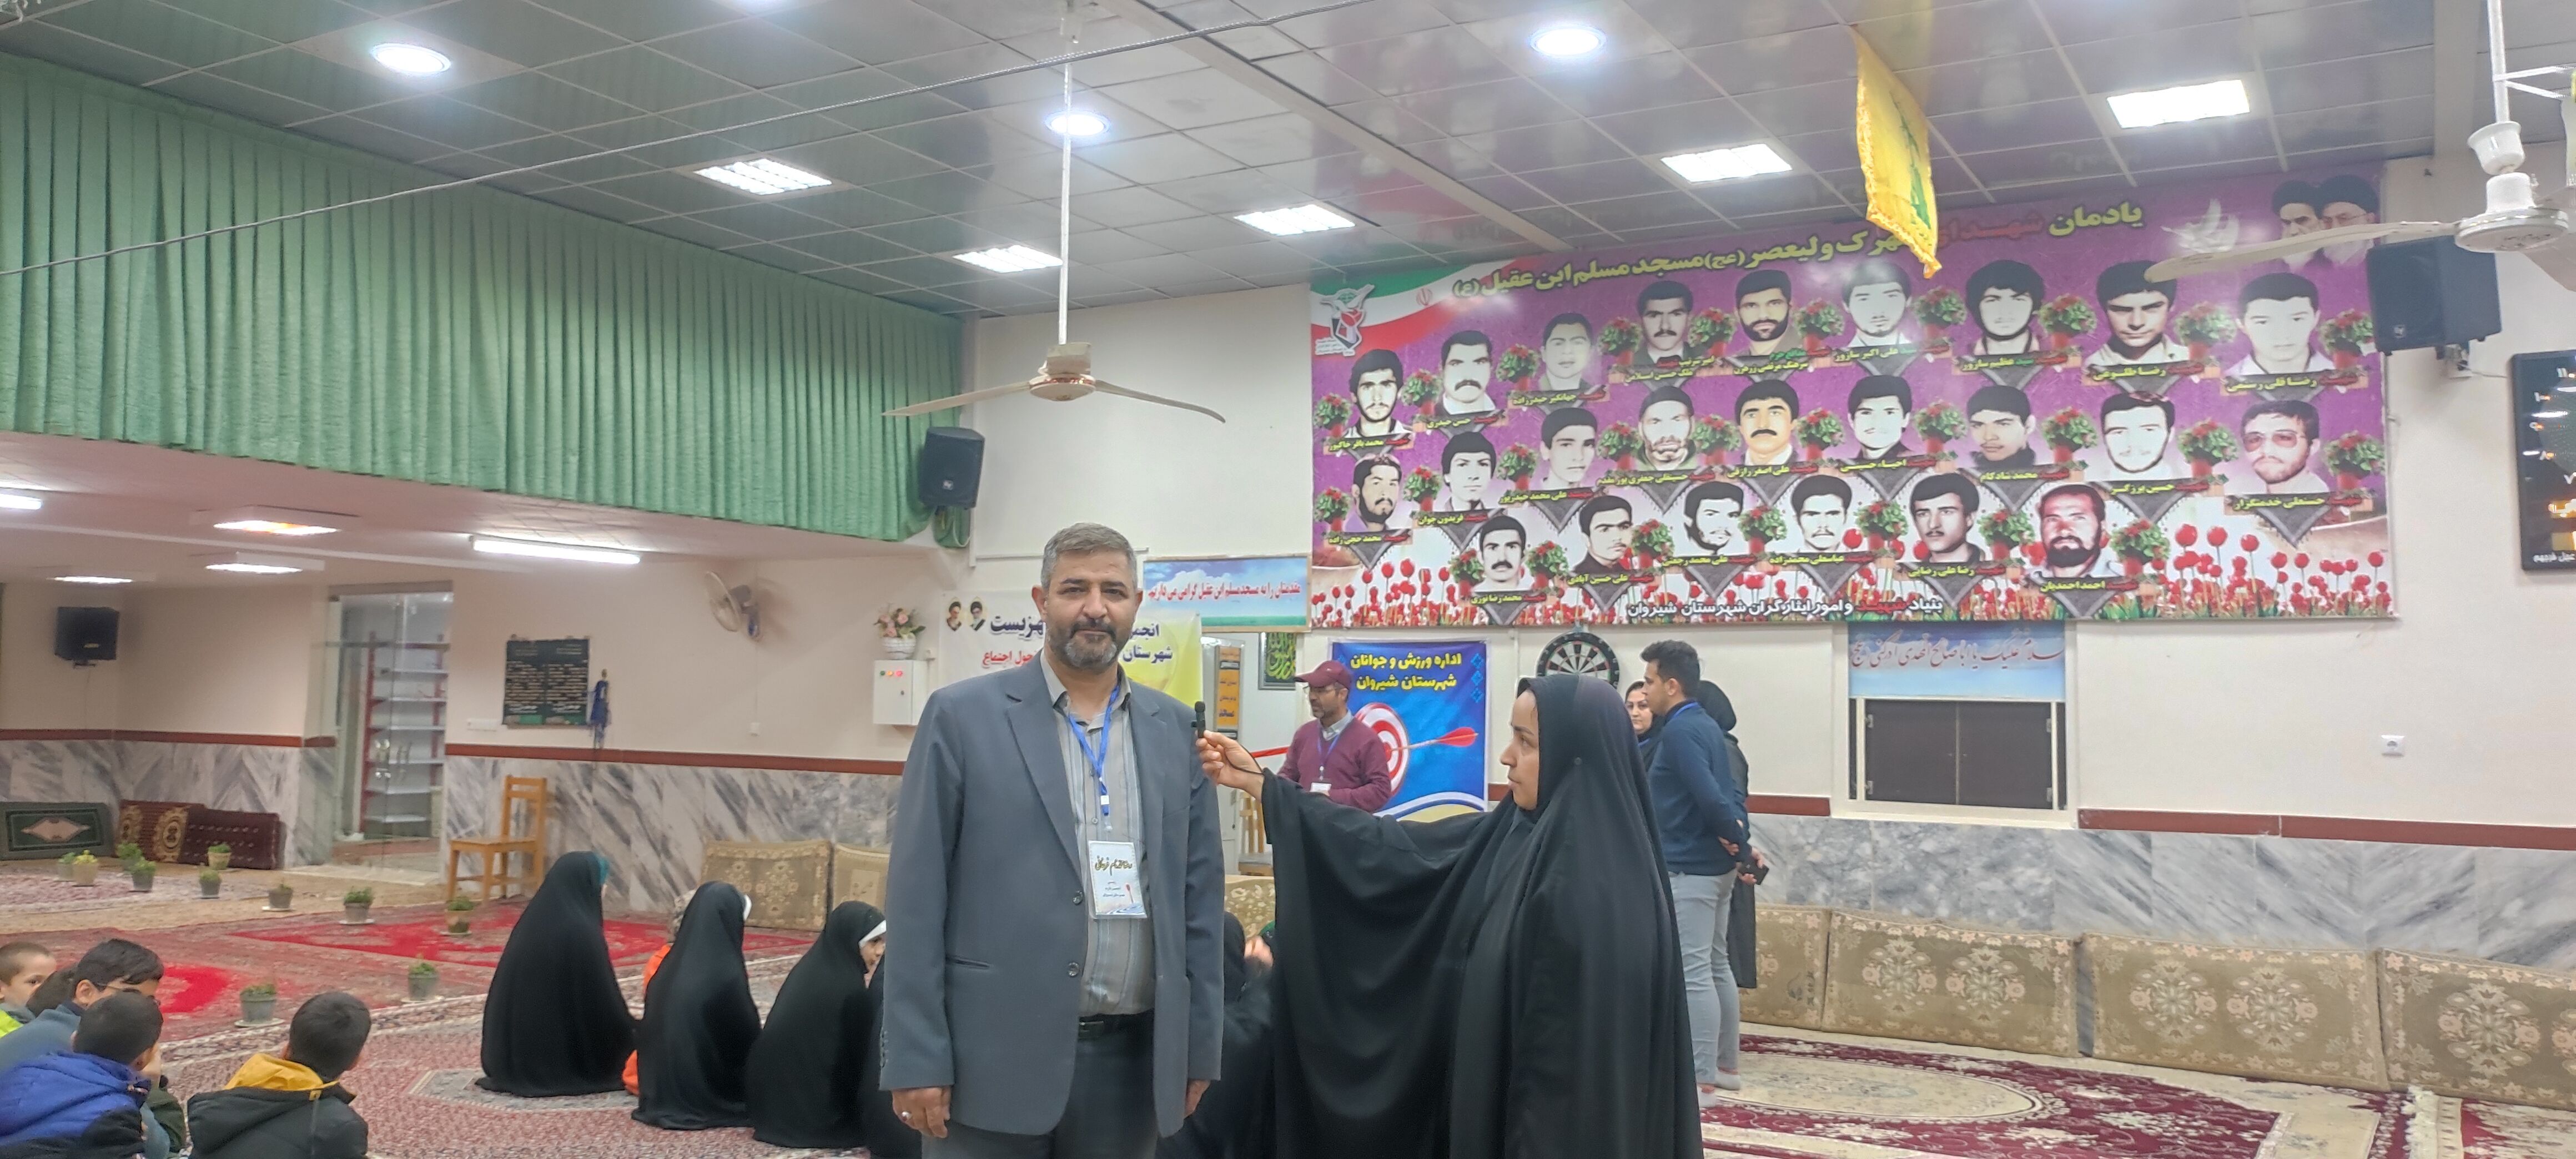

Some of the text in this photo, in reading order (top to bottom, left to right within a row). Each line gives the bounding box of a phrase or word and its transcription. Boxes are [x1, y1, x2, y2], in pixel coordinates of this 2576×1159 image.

[2049, 201, 2143, 236] یادمان
[1745, 235, 1833, 269] ولیعصر
[1573, 259, 1630, 286] مسلم
[1632, 256, 1704, 277] مسجد
[1481, 269, 1533, 296] عقیل
[1535, 263, 1572, 290] ابن
[1627, 601, 1677, 617] شیروان
[1681, 601, 1747, 616] شهرستان
[1909, 598, 1943, 613] بنیاد
[1131, 623, 1159, 640] انجم
[1350, 652, 1462, 669] اداره ورزش و جوانان
[1356, 673, 1457, 691] شهرستان شیروان
